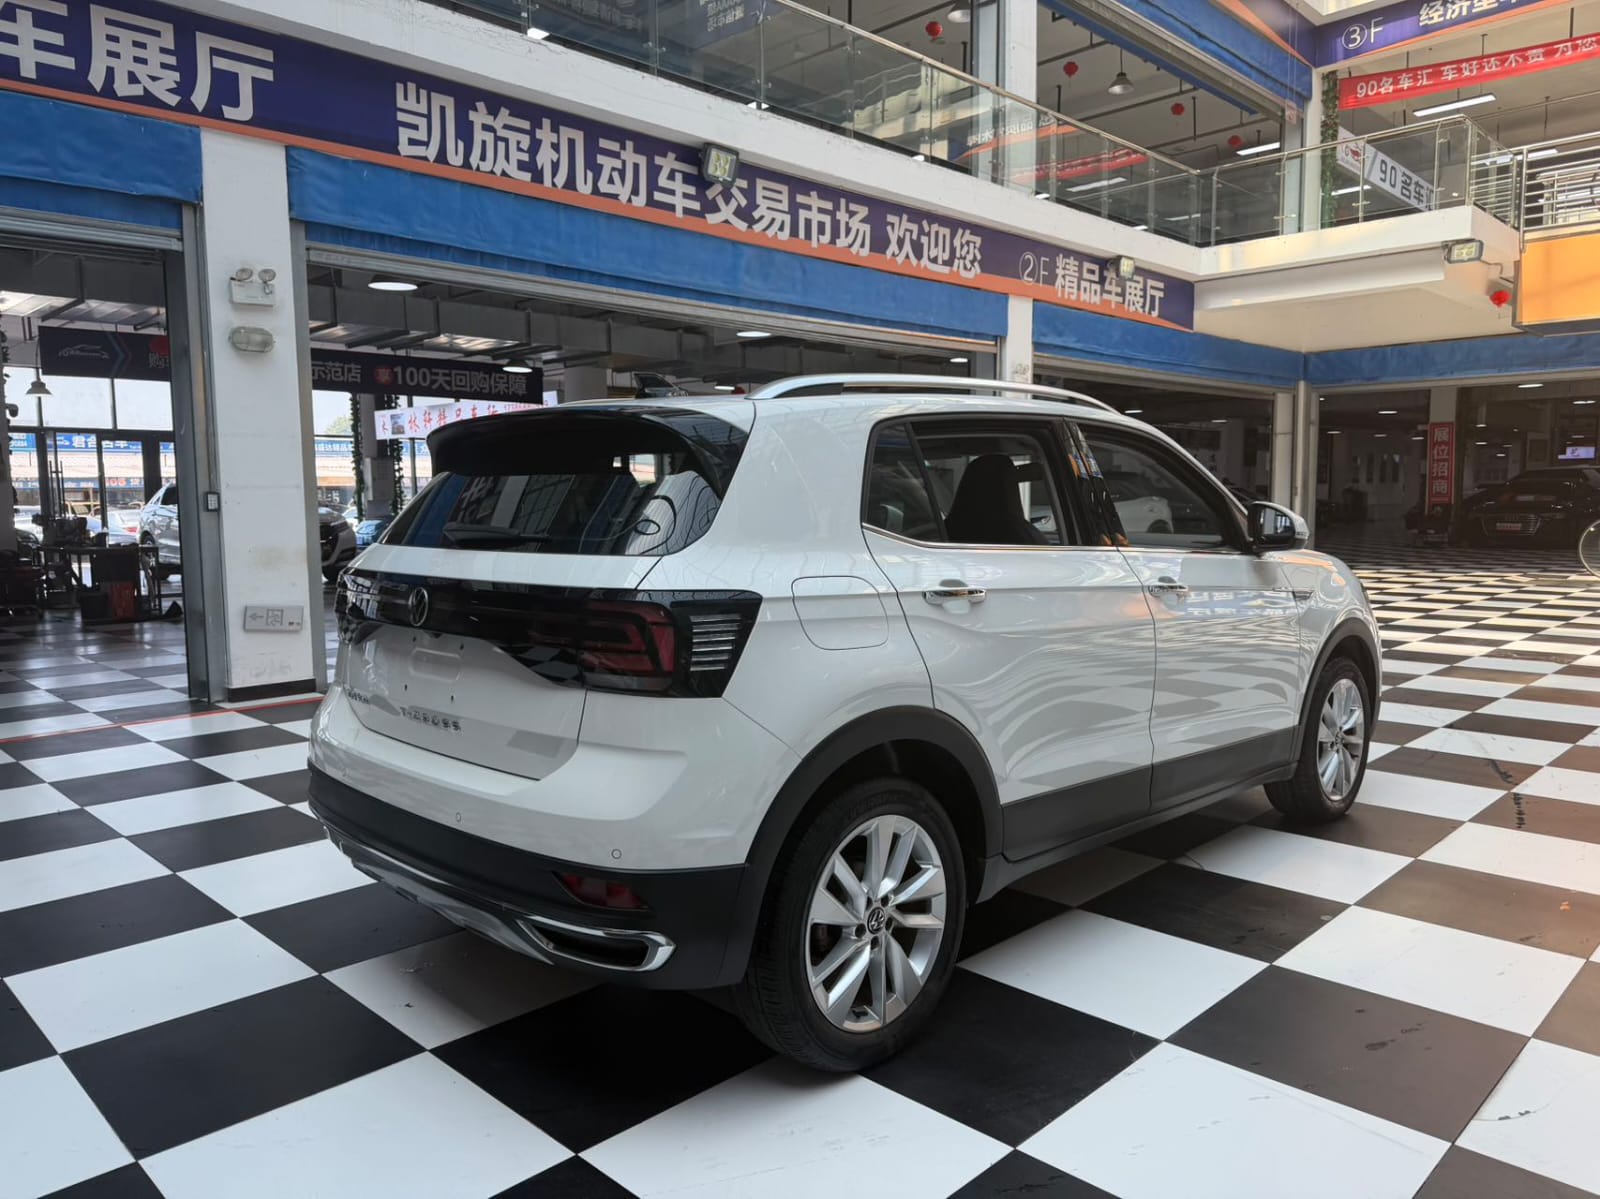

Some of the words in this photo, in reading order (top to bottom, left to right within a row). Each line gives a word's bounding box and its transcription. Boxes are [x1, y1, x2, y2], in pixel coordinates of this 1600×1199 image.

[0, 1, 275, 121] 车展厅
[1356, 69, 1435, 98] 90名车汇
[395, 81, 871, 257] 凯旋机动车交易市场
[886, 212, 983, 279] 欢迎您
[1055, 253, 1165, 318] 精品车展厅
[1431, 427, 1450, 495] 展位招商
